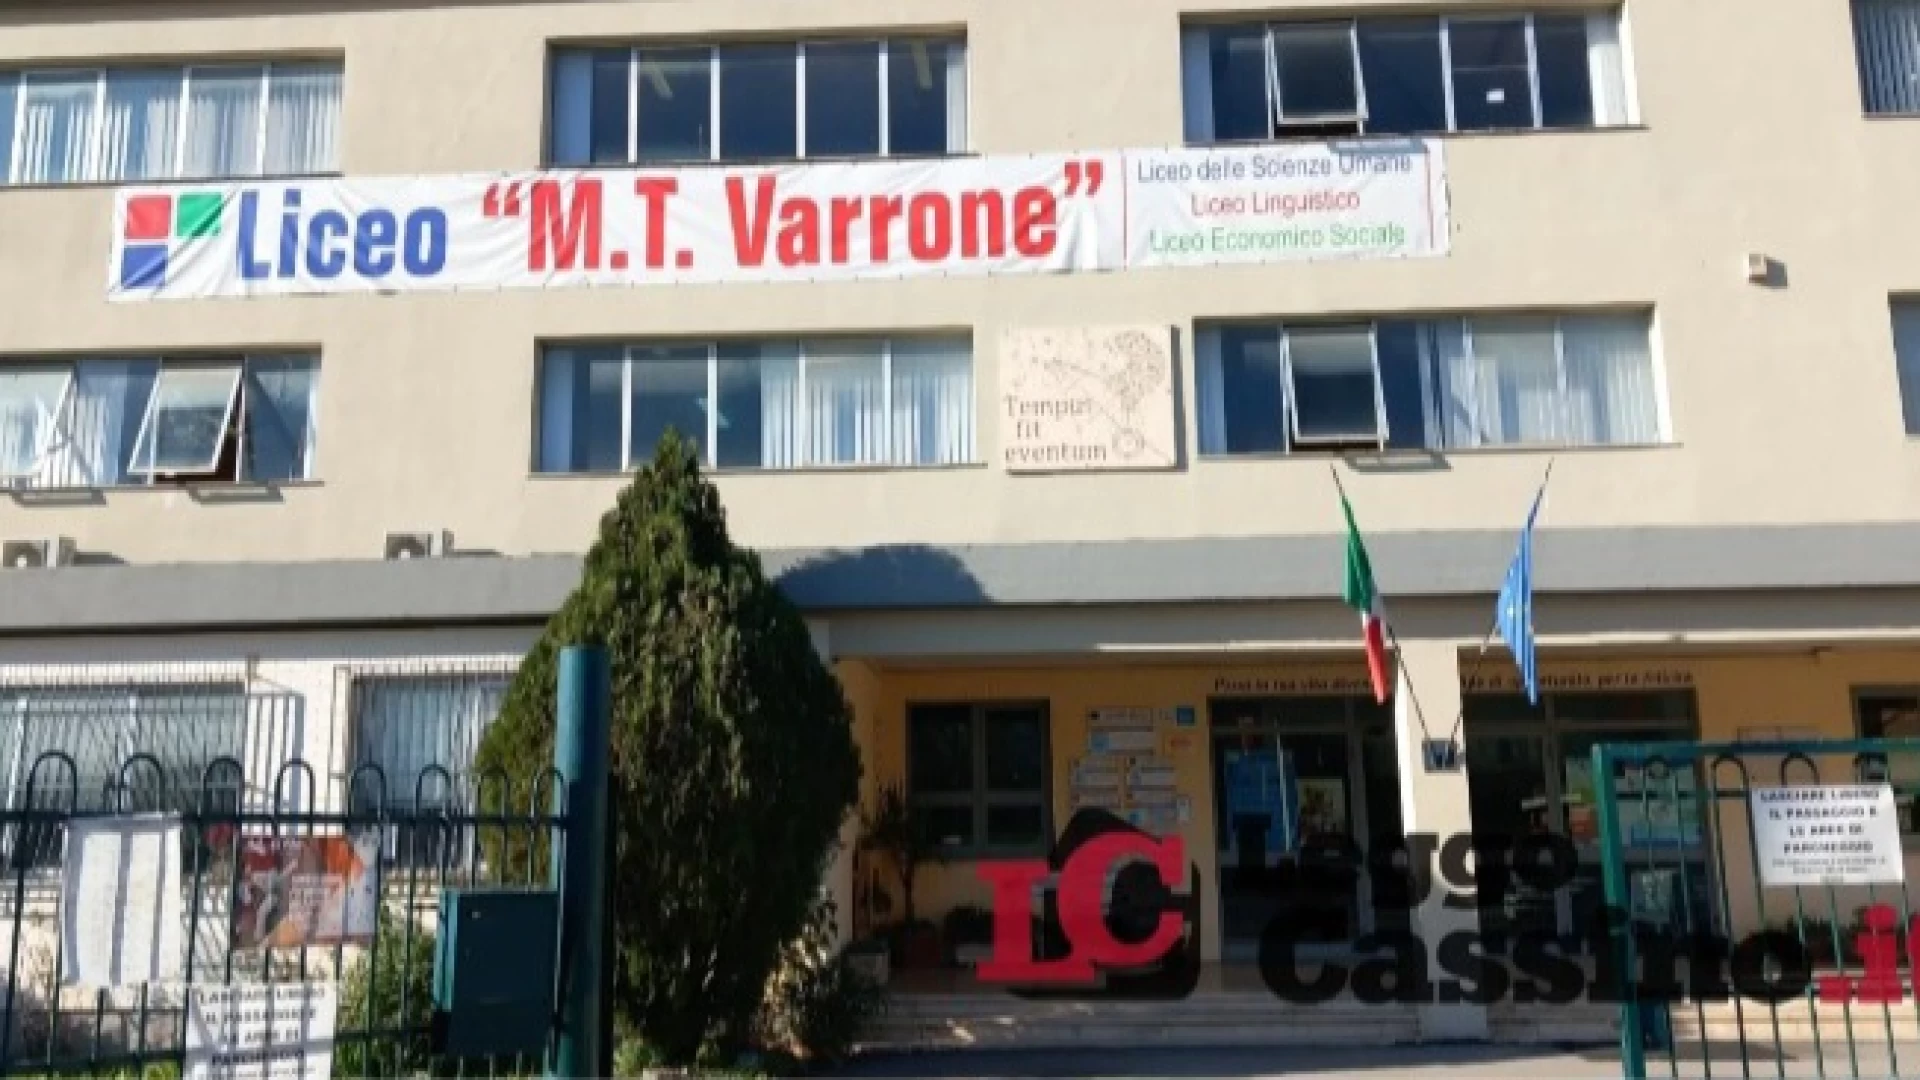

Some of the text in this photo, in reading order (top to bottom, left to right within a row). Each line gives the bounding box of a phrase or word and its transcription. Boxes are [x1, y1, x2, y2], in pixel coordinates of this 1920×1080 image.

[1138, 150, 1413, 183] Liceo delle Scienze Umane
[1191, 189, 1361, 218] Liceo Linguistico
[235, 188, 448, 282] Liceo
[1150, 220, 1406, 252] Liceo Economico Sociale
[1016, 420, 1040, 439] fit
[1005, 443, 1107, 463] eventum
[1786, 805, 1866, 820] PASSAGGIO
